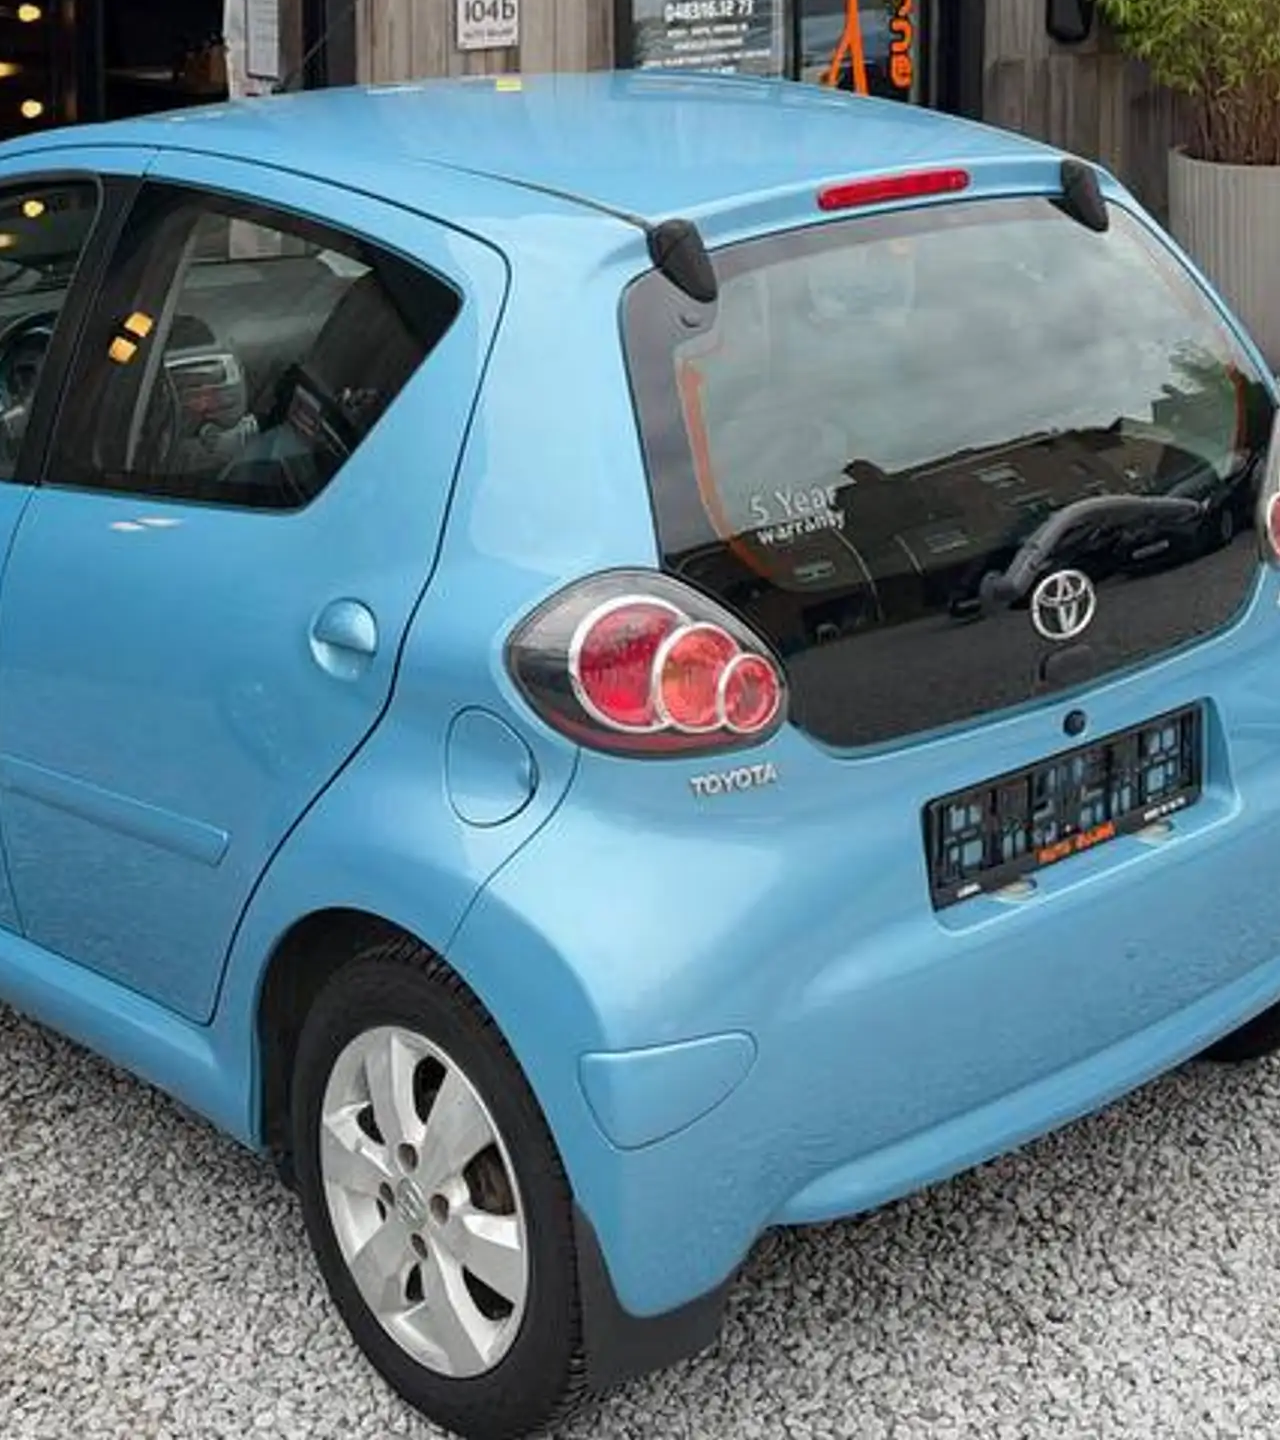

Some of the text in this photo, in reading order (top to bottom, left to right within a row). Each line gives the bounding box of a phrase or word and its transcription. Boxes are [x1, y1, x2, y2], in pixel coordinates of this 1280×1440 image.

[750, 485, 837, 525] 5 Year
[756, 510, 846, 545] warranty
[688, 762, 779, 797] TOYOTA
